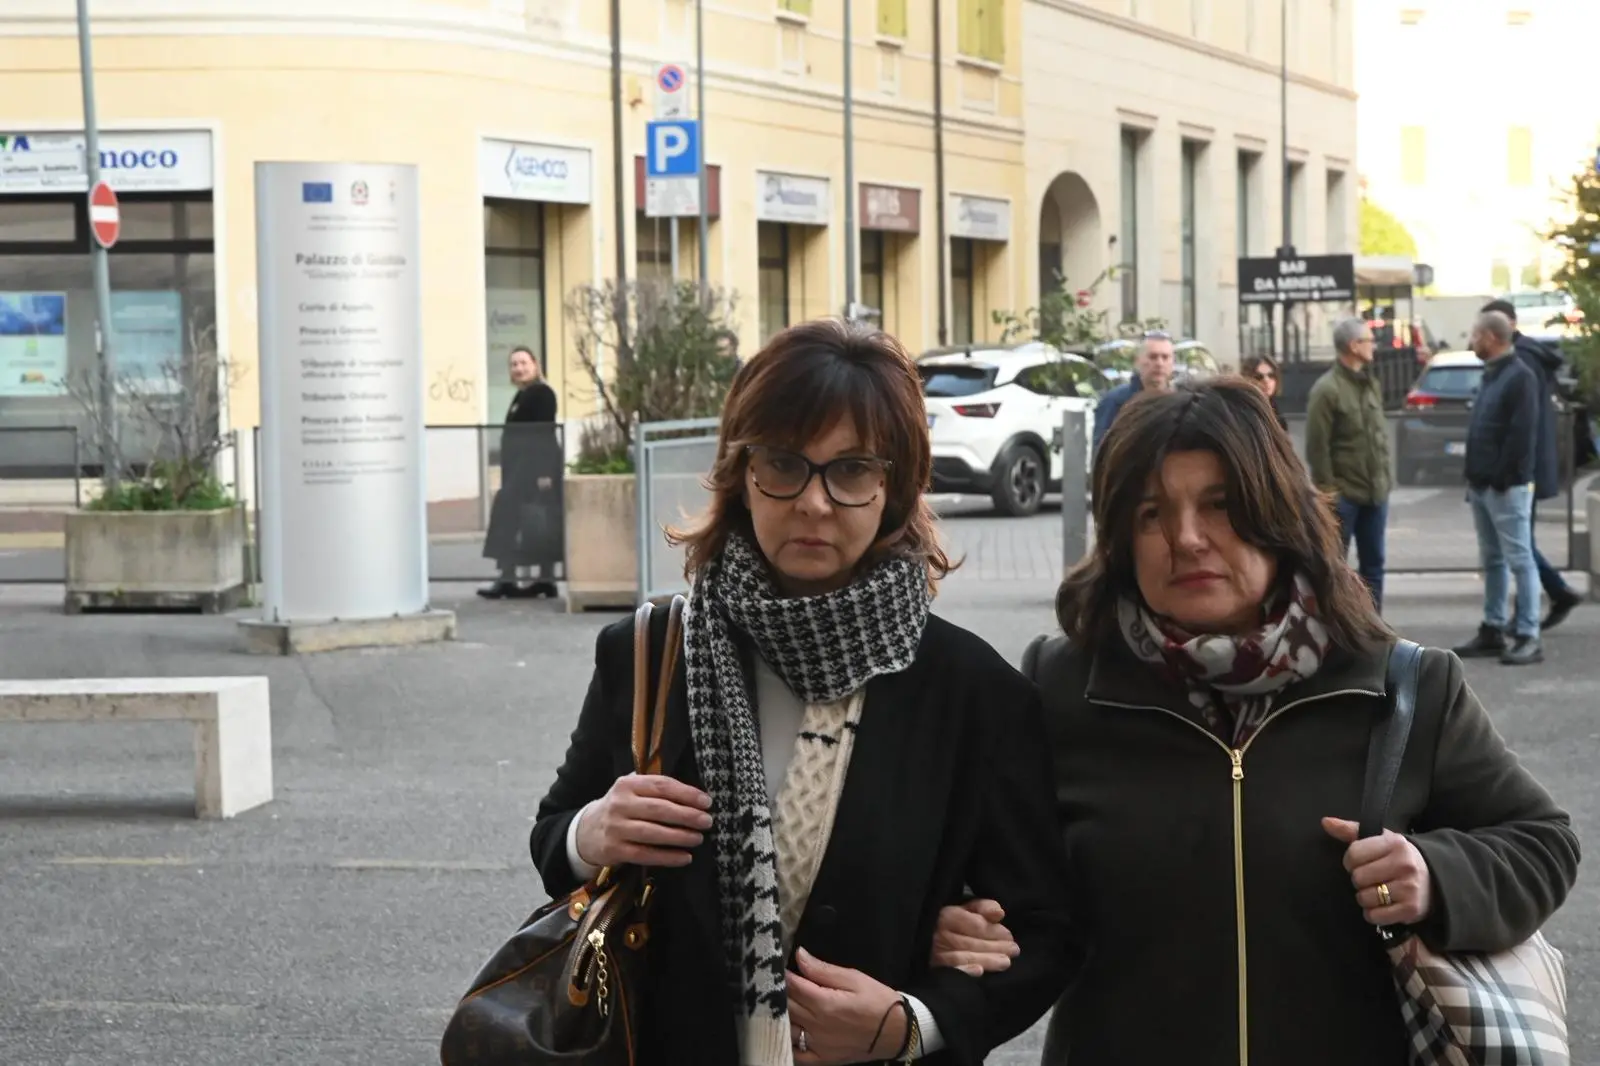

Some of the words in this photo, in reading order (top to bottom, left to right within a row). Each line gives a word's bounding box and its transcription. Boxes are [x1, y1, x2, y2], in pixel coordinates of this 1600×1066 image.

[655, 125, 690, 173] P
[295, 253, 348, 266] Palazzo
[1279, 260, 1307, 274] BAR
[1253, 277, 1275, 292] DA
